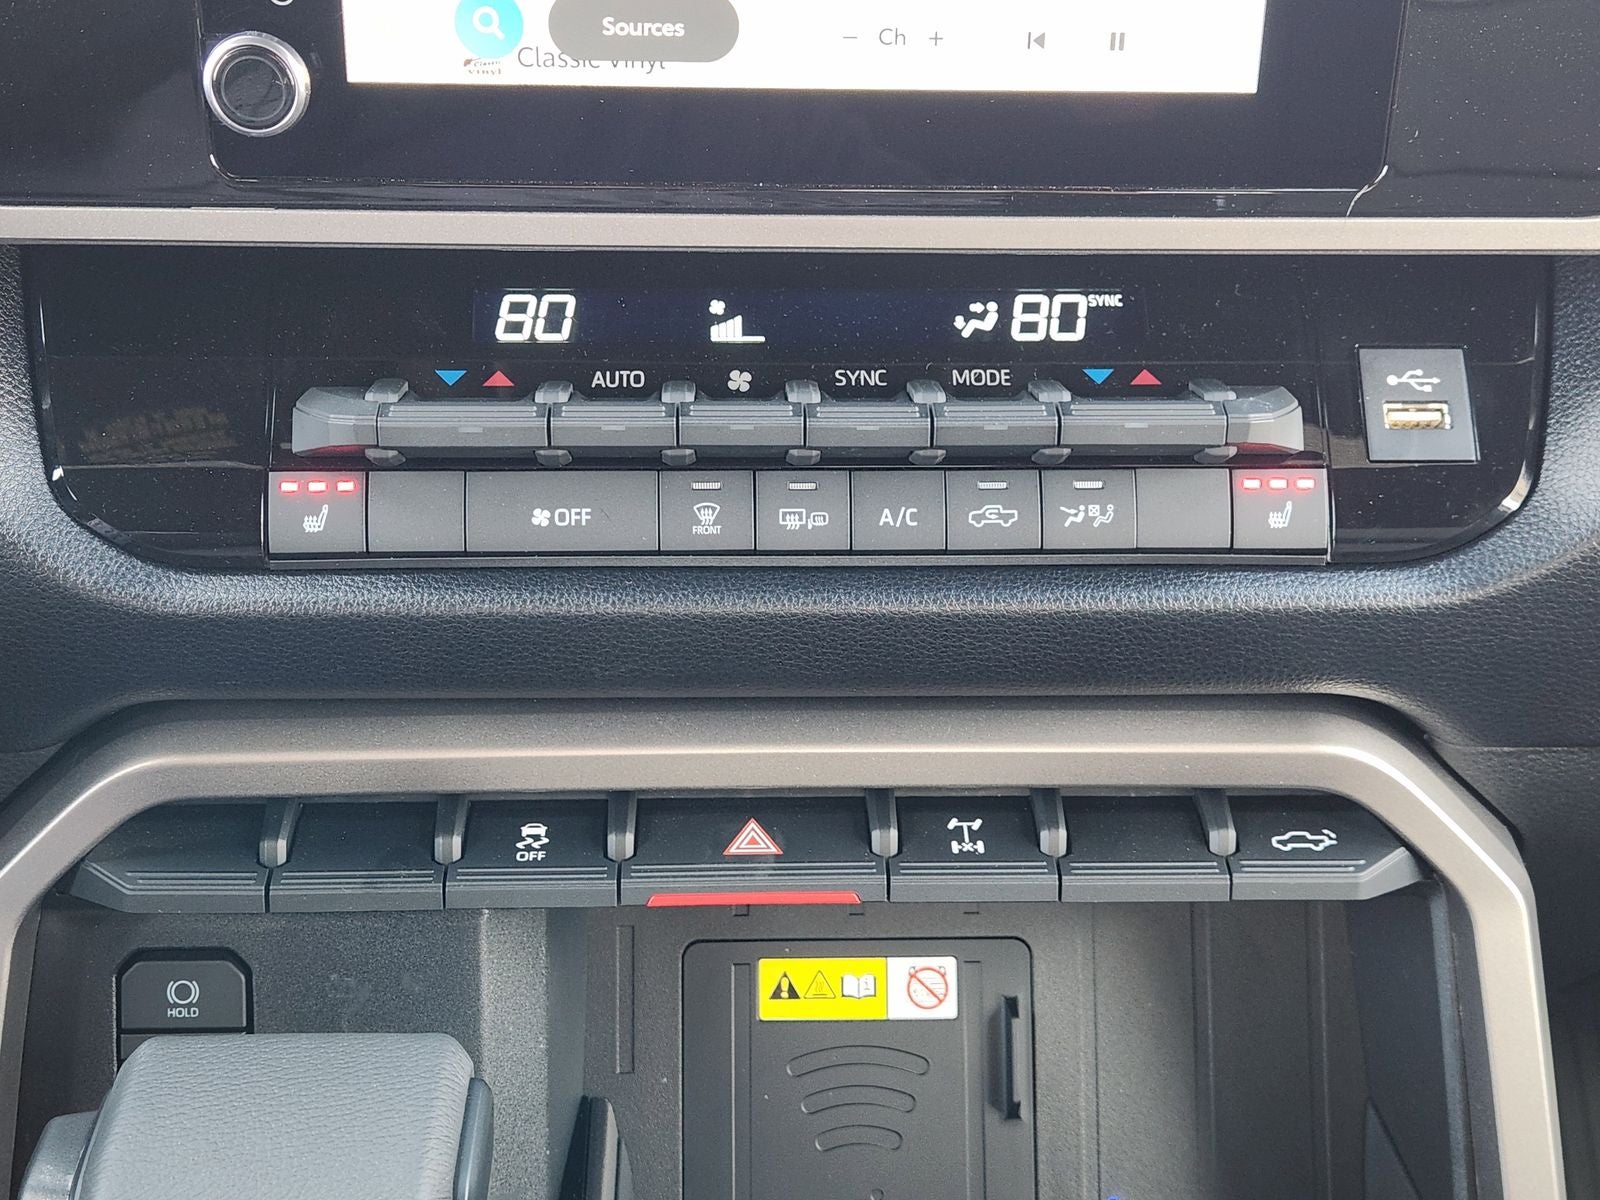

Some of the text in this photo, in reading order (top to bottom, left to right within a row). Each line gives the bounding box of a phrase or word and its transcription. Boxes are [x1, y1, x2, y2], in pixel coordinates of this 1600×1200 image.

[602, 16, 685, 37] Sources
[878, 28, 906, 46] Ch
[1087, 293, 1124, 307] SYNC
[494, 293, 577, 341] 80
[1010, 293, 1087, 341] 80
[591, 370, 645, 388] AUTO
[834, 369, 888, 386] SYNC
[952, 369, 1012, 386] MODE
[554, 507, 592, 527] OFF
[878, 507, 919, 528] A/C
[692, 525, 723, 535] FRONT
[515, 850, 547, 862] OFF
[167, 1007, 199, 1018] HOLD
